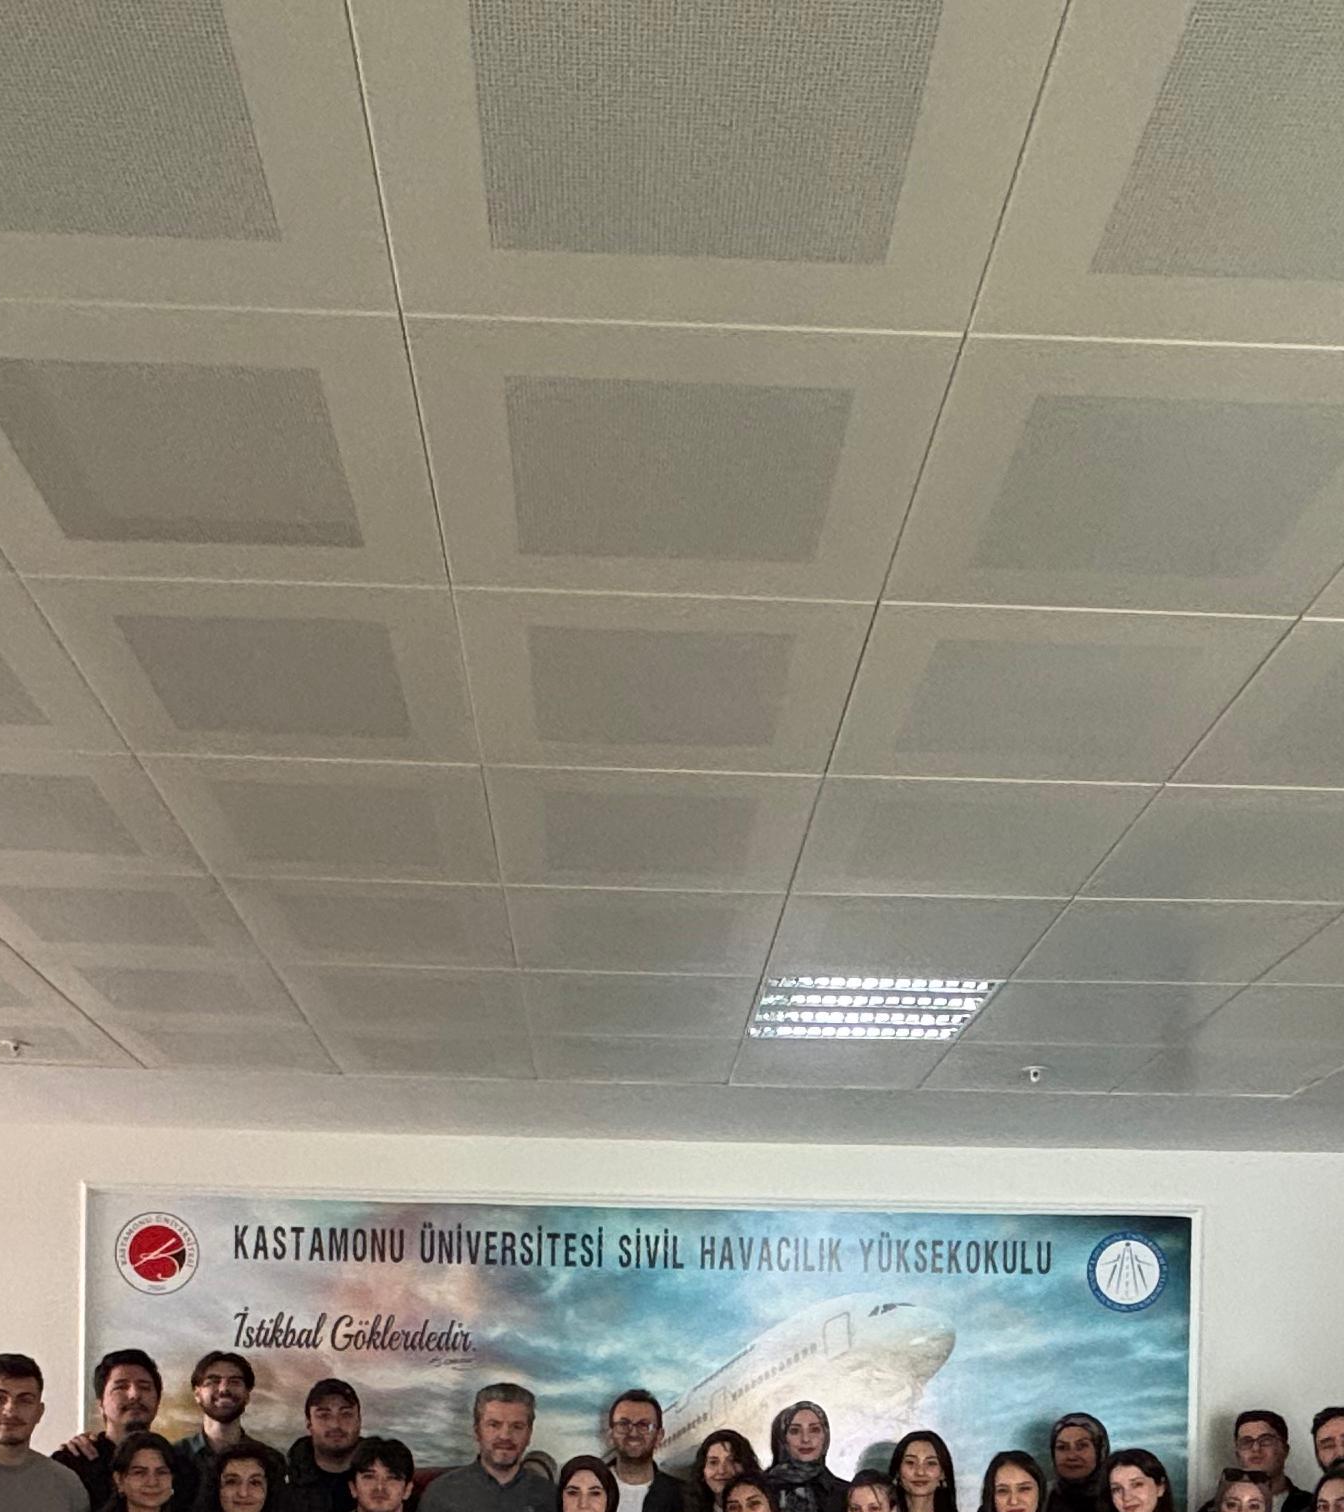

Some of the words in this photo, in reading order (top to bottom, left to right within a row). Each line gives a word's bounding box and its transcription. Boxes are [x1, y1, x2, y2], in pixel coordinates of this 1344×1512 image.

[234, 1225, 405, 1264] KASTAMONU
[420, 1222, 604, 1268] ÜNİVERSİTESİ
[618, 1227, 685, 1271] SİVİL
[700, 1233, 843, 1273] HAVACILIK
[859, 1231, 1053, 1276] YÜKSEKOKULU
[233, 1306, 327, 1350] İstikbal
